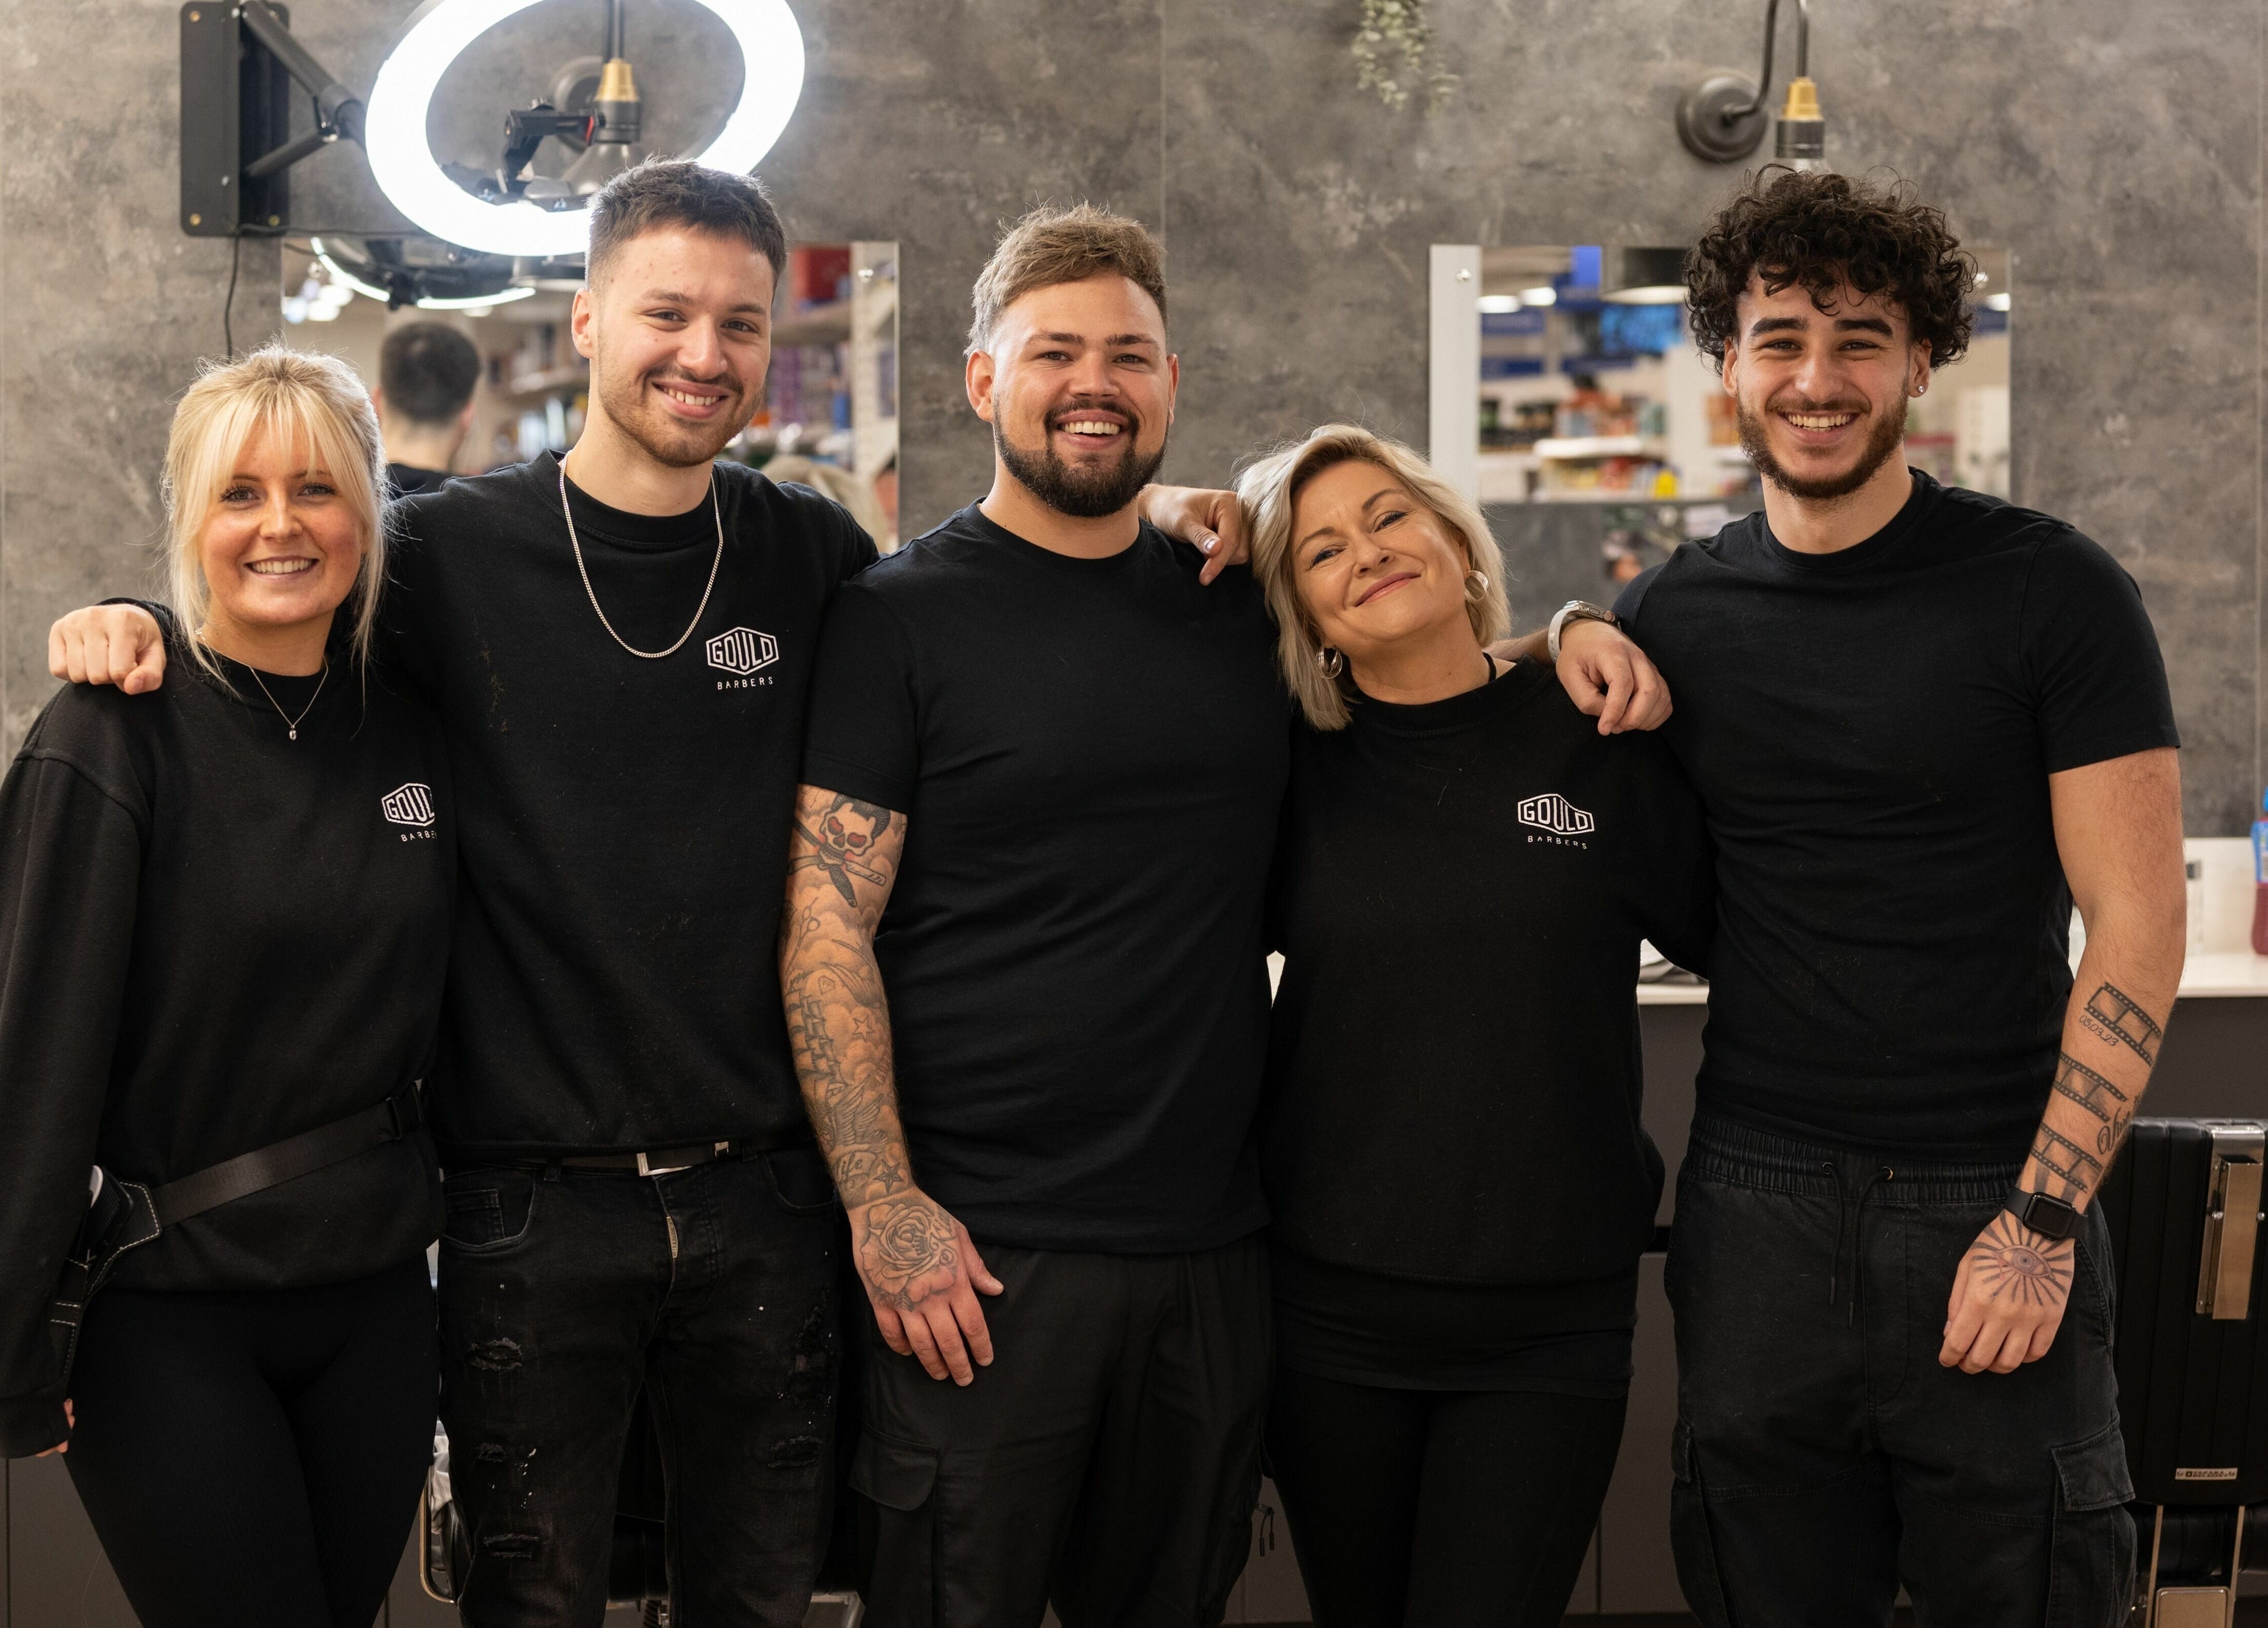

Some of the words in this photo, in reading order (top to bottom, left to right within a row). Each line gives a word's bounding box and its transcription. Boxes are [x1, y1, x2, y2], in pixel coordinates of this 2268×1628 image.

[712, 631, 774, 670] GOULD
[717, 676, 773, 690] BARBERS
[386, 787, 435, 822] GOUL
[1523, 797, 1589, 831] GOULD
[400, 830, 437, 842] BARBE
[1527, 835, 1587, 849] BARBERS
[2079, 1015, 2119, 1046] 05.03.23
